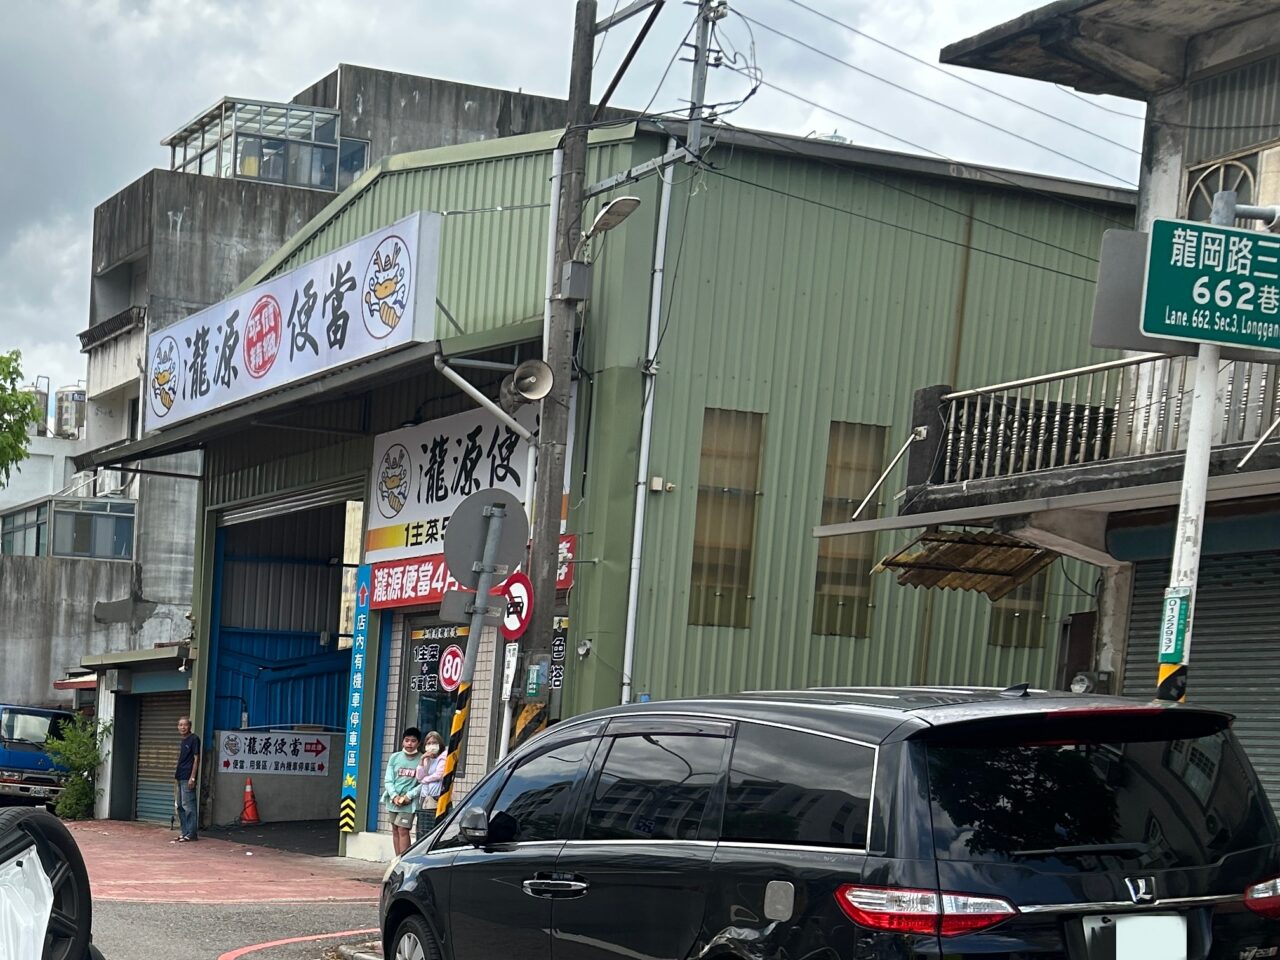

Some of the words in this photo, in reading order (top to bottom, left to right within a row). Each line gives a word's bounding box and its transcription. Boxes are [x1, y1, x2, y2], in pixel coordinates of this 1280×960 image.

[1192, 276, 1280, 315] 662巷
[1165, 305, 1189, 327] Lane.
[1241, 315, 1280, 342] Longgan
[413, 643, 440, 662] 1主菜
[410, 673, 439, 691] 5副菜
[442, 654, 461, 682] 80
[347, 613, 367, 767] 店內有機車停車區
[243, 736, 303, 758] 瀧源便當
